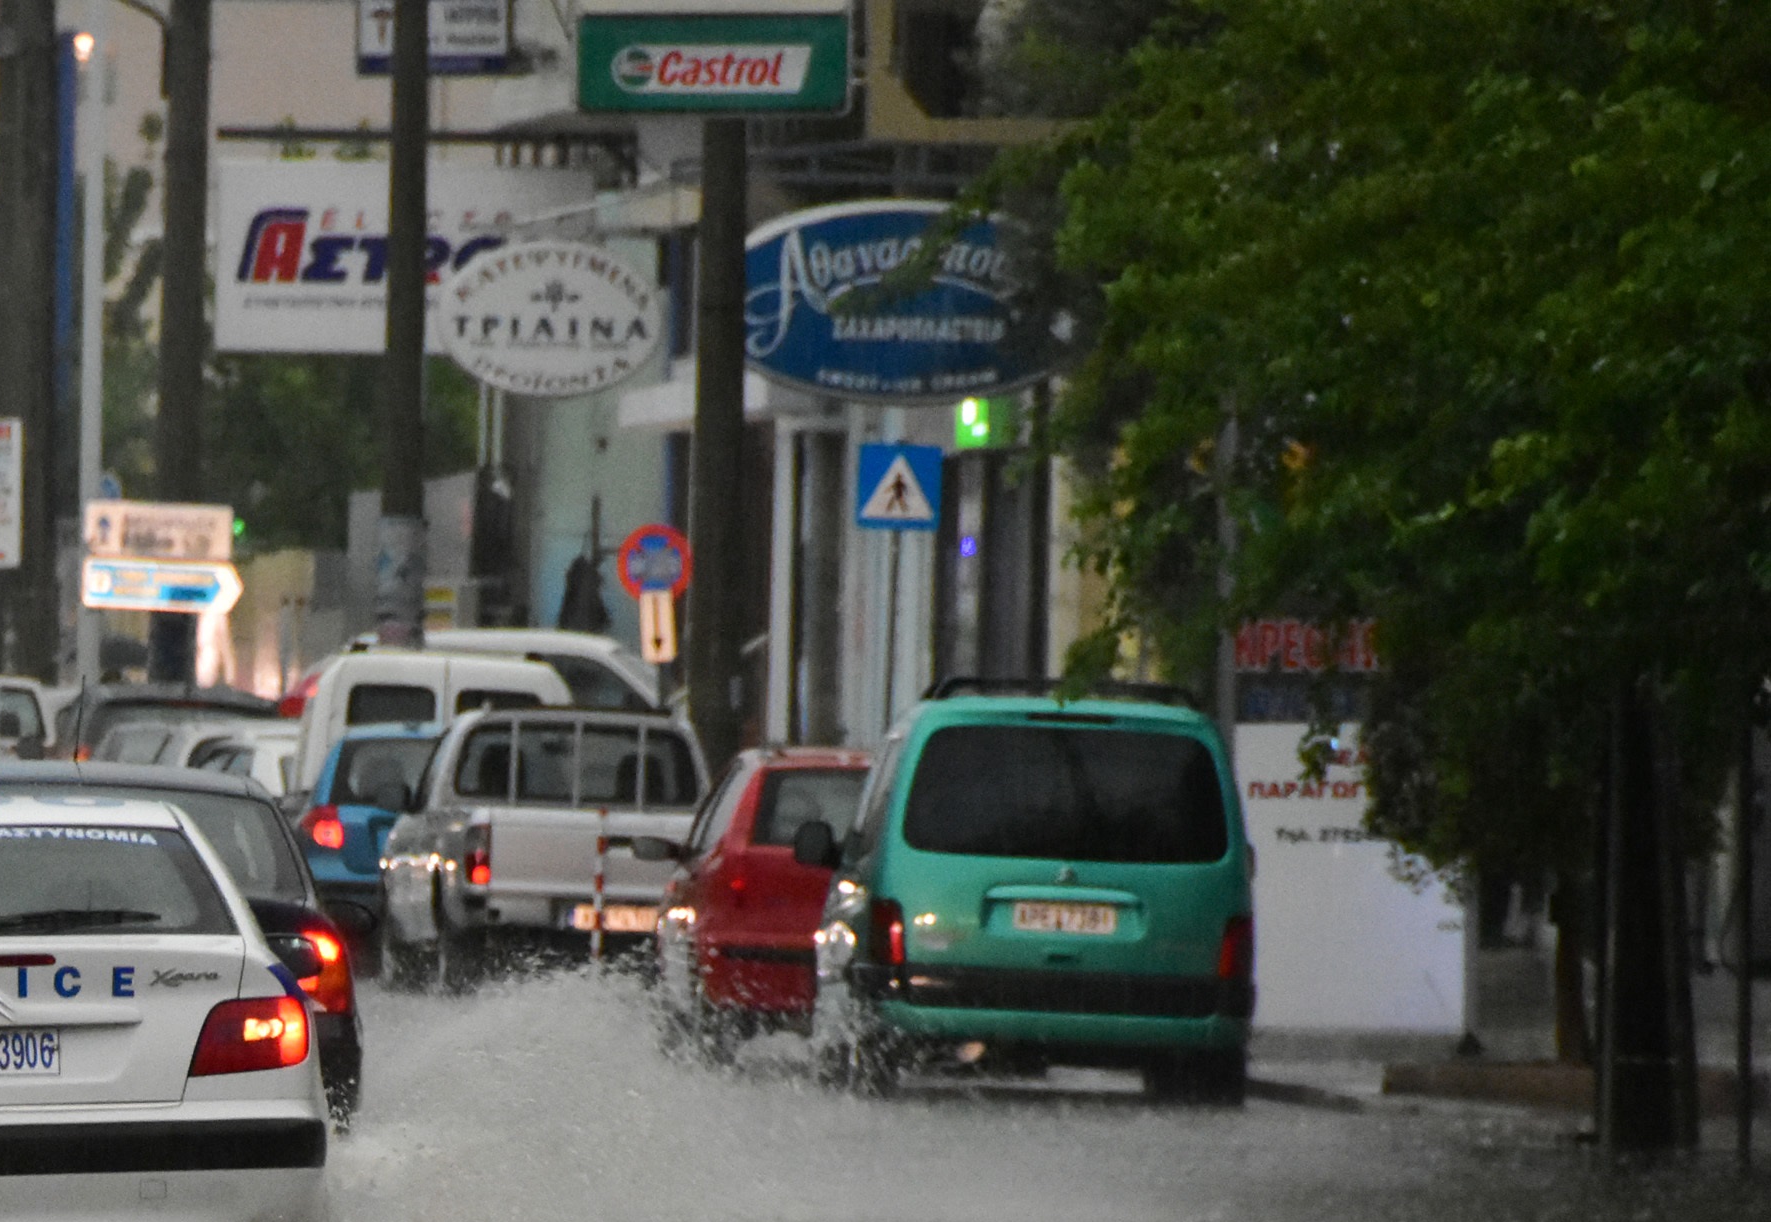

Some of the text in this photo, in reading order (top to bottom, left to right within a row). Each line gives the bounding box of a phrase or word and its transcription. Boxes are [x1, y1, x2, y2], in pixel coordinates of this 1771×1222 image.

[658, 50, 783, 87] Castrol
[454, 314, 647, 340] ΤΡΙΑΙΝΑ
[1248, 781, 1365, 798] ΠΑΡΑΓΩΓ
